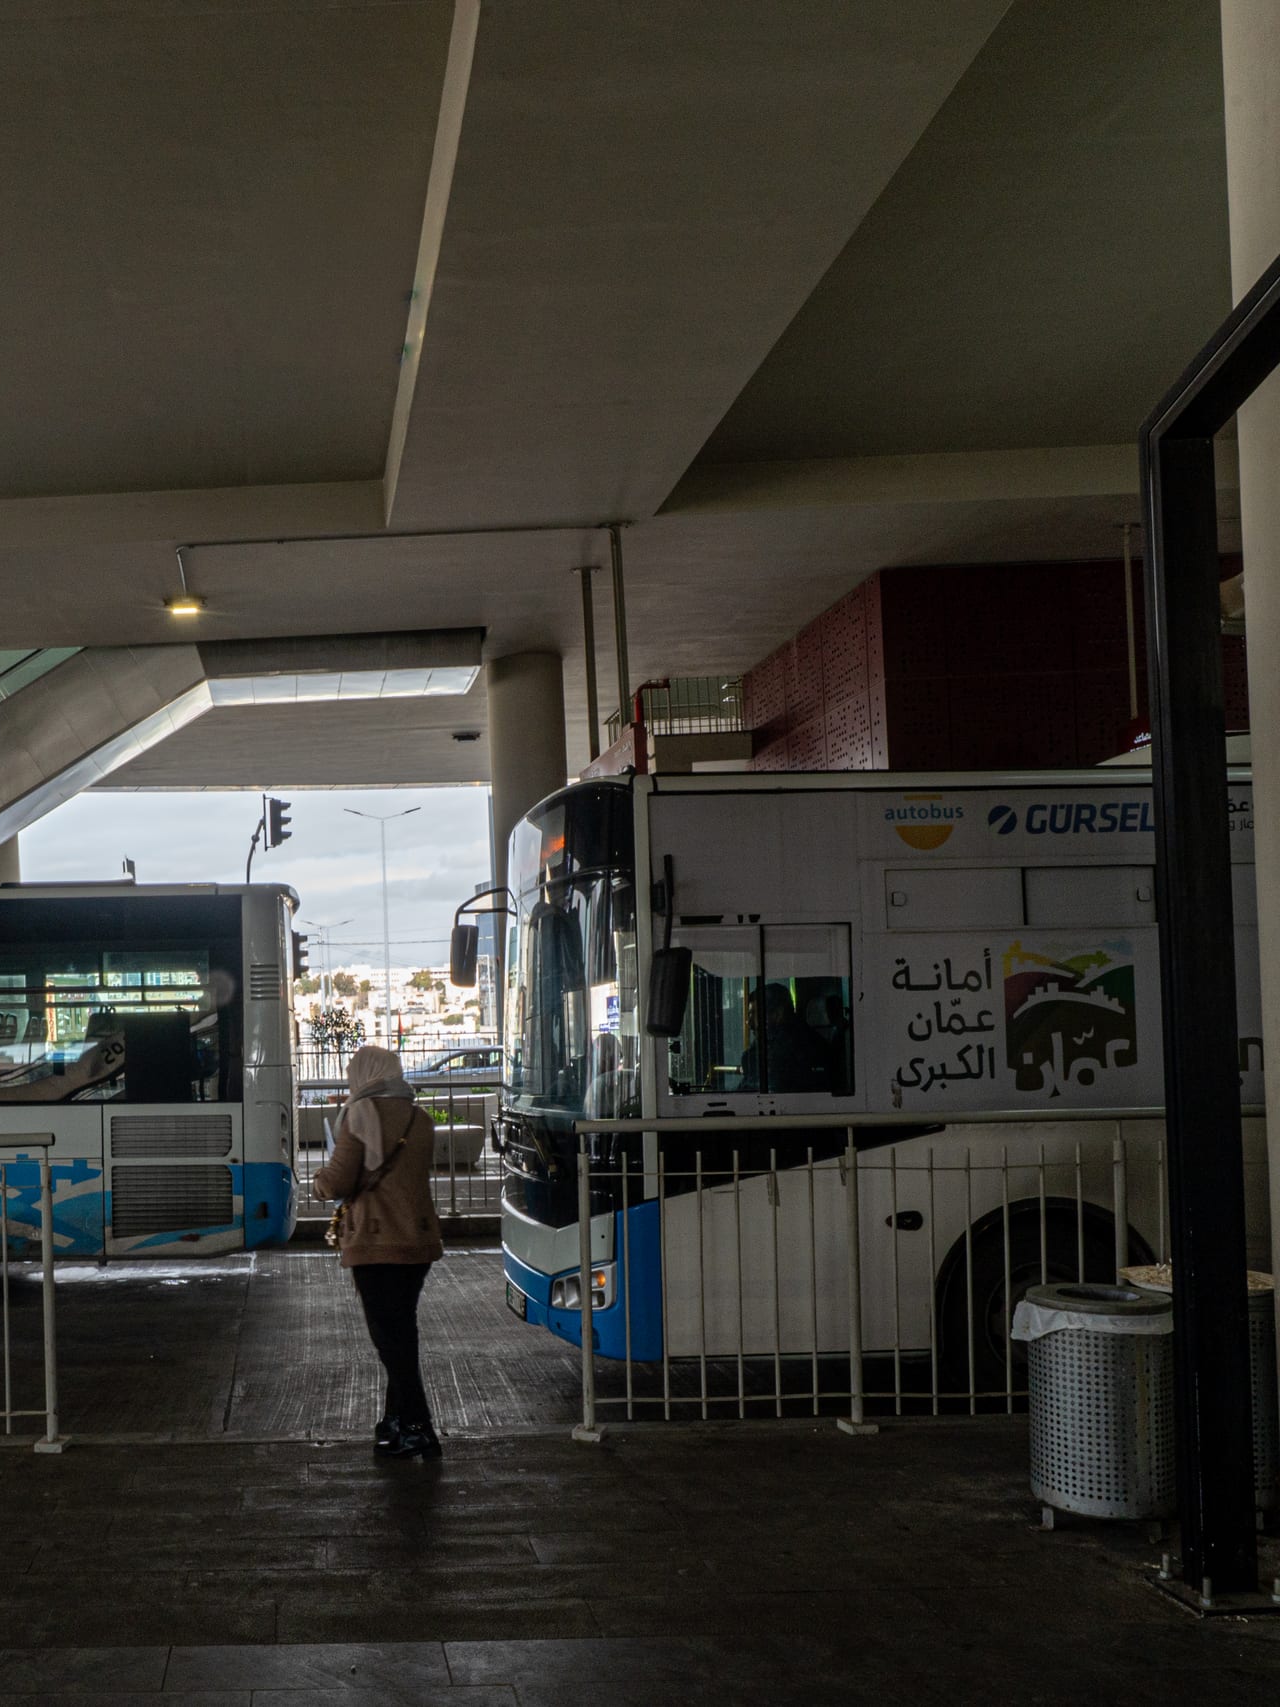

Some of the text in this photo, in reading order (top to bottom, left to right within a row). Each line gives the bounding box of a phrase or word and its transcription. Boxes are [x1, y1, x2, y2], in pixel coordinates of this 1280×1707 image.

[884, 803, 964, 822] autobus
[1025, 802, 1156, 834] GÜRSEL
[897, 1044, 995, 1092] الكبرى
